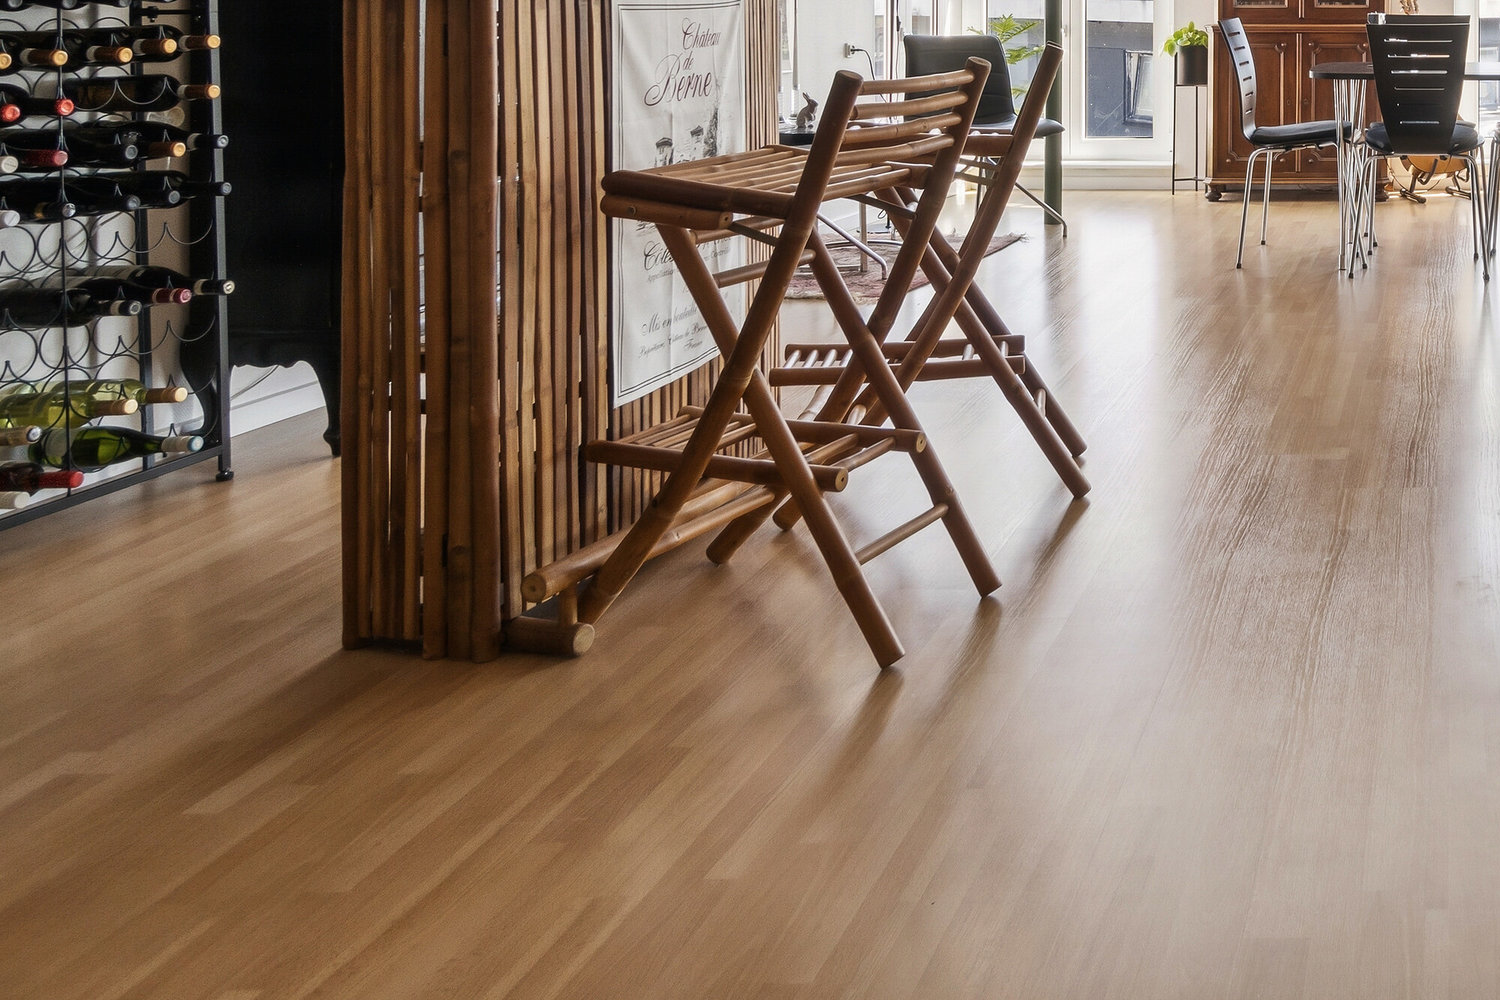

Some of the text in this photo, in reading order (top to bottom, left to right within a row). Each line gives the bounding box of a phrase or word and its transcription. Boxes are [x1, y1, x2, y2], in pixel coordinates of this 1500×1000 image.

[681, 17, 721, 50] Château
[683, 51, 694, 70] de
[644, 53, 712, 107] Berne
